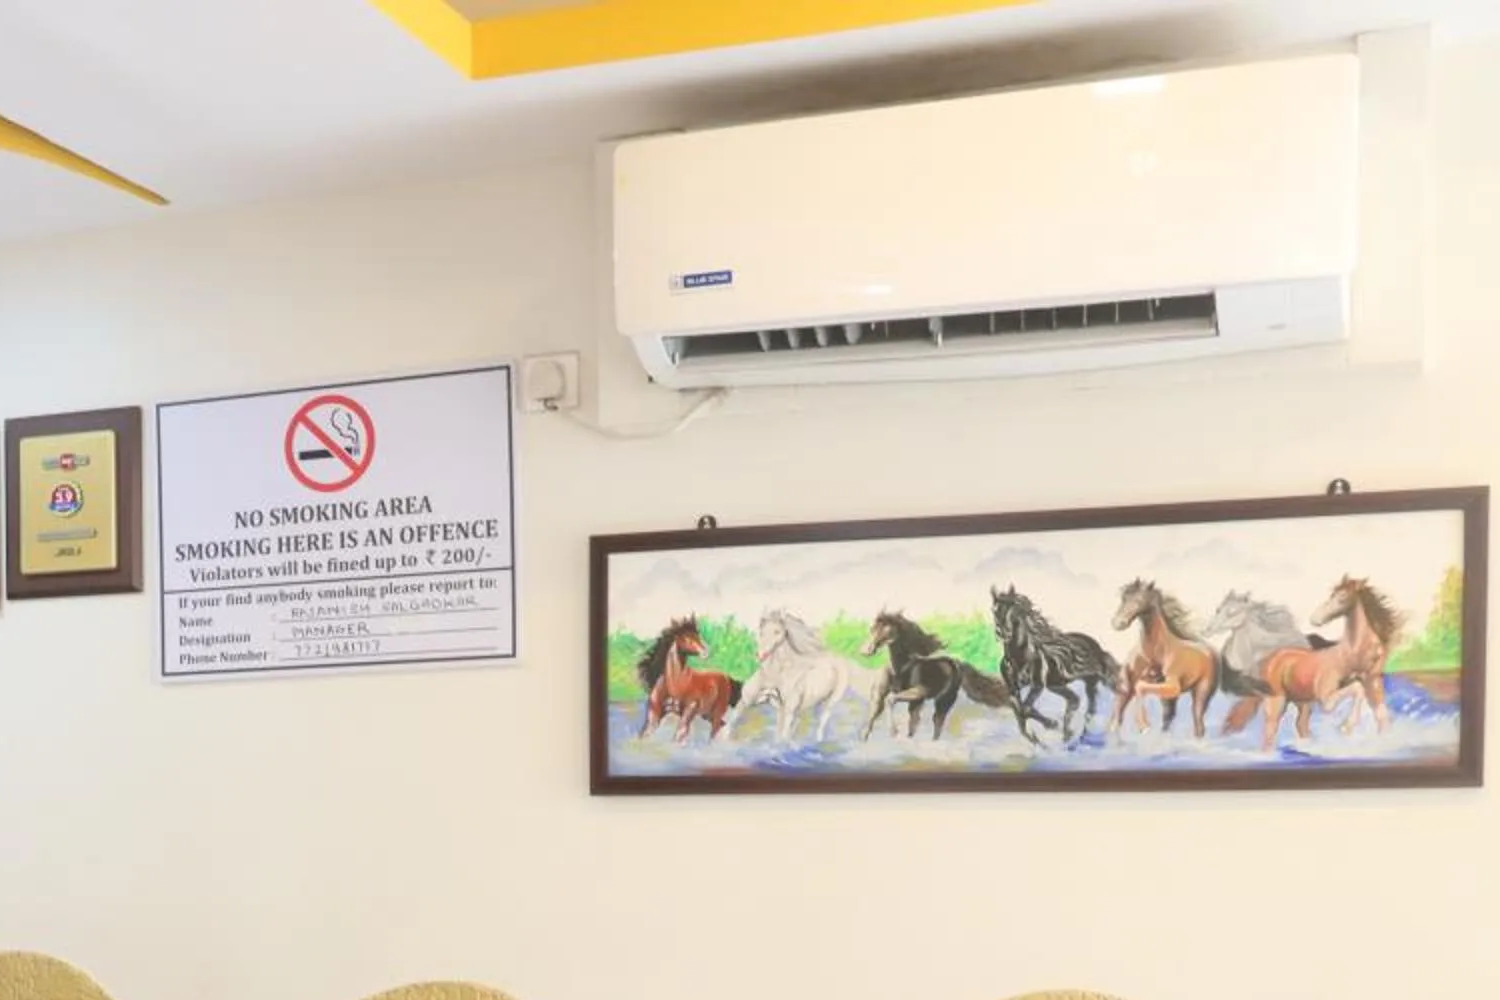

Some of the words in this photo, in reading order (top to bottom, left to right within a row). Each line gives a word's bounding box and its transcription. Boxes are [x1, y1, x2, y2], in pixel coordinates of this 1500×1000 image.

[234, 509, 264, 530] NO
[269, 500, 368, 526] SMOKING
[374, 495, 433, 515] AREA
[175, 537, 271, 562] SMOKING
[277, 532, 334, 554] HERE
[339, 531, 359, 549] IS
[365, 527, 393, 546] AN
[399, 519, 499, 543] OFFENCE
[189, 564, 264, 584] Violators
[267, 558, 299, 575] will
[303, 557, 323, 574] be
[327, 554, 370, 572] fined
[374, 555, 398, 573] up
[401, 553, 419, 567] to
[442, 545, 492, 565] 200/-
[179, 597, 188, 609] If
[191, 597, 221, 611] your
[225, 594, 252, 606] find
[255, 588, 313, 607] anybody
[317, 584, 376, 600] smoking
[379, 581, 425, 598] please
[429, 578, 479, 595] report
[479, 576, 498, 590] to:
[179, 616, 213, 629] Name
[179, 632, 251, 647] Designation
[179, 653, 217, 665] Phone
[219, 650, 268, 664] Number
